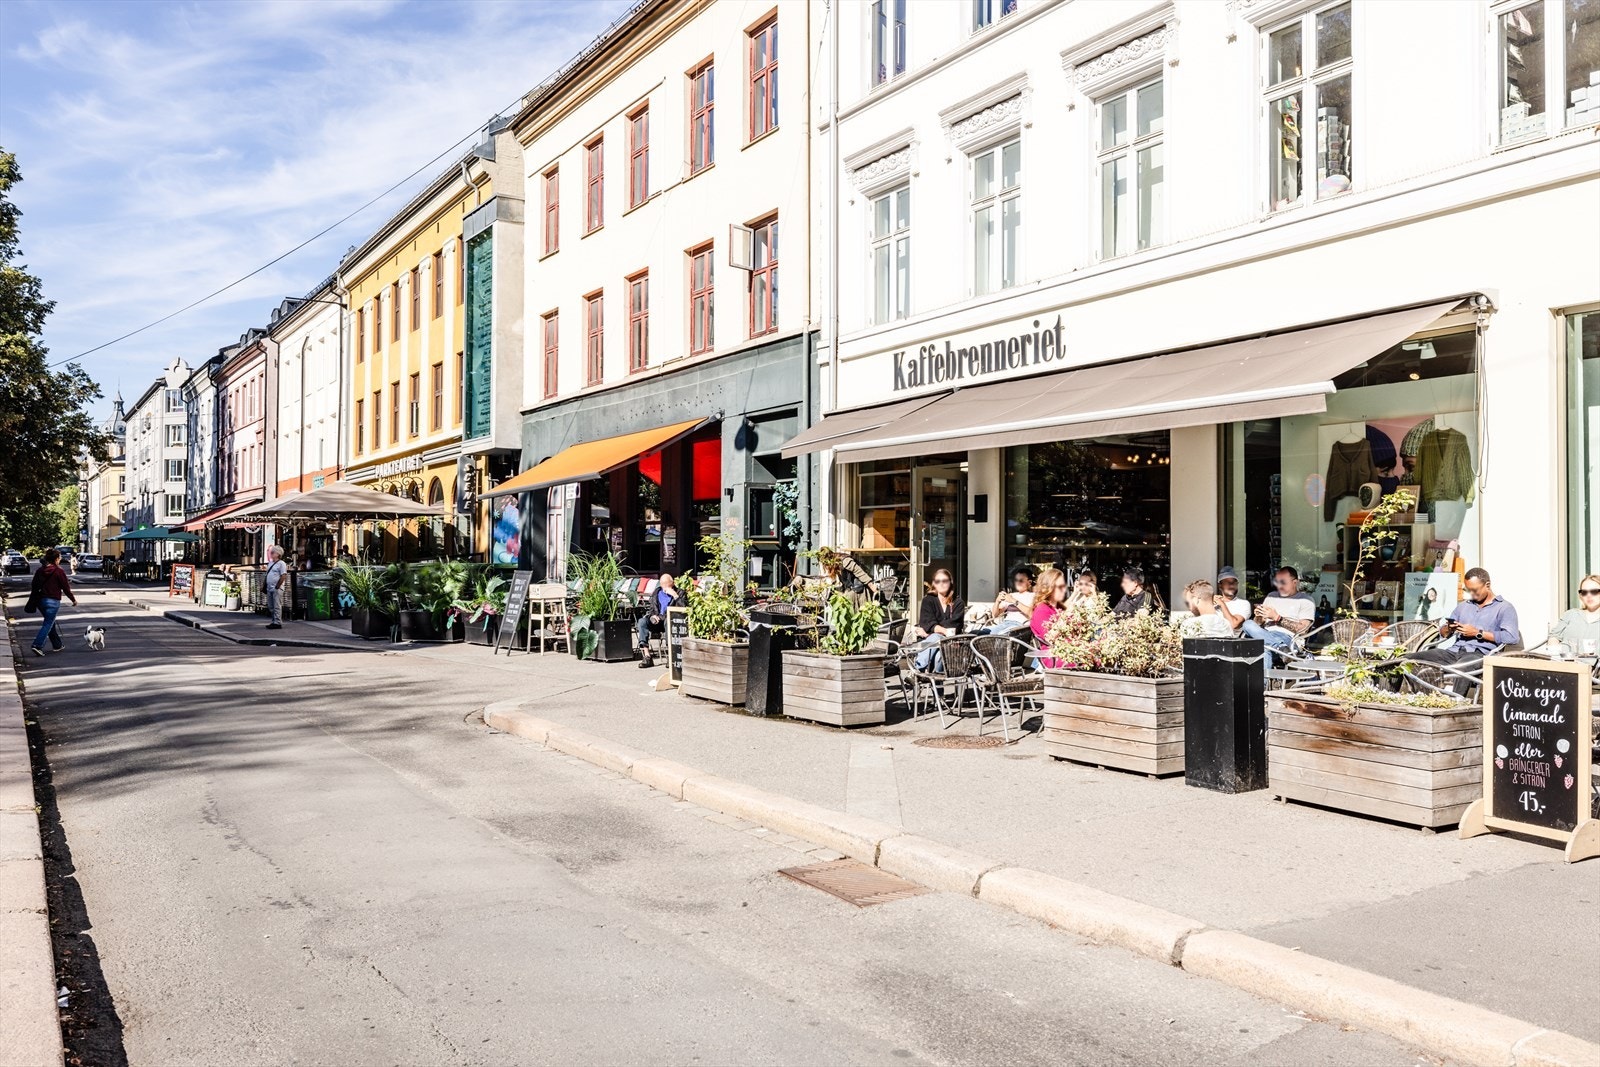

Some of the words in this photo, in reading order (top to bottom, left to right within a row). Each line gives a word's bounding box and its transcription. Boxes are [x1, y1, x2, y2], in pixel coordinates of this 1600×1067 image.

[893, 314, 1066, 391] Kaffebrenneriet
[375, 454, 423, 478] PARKTEATRET
[463, 464, 473, 509] SCENE
[1496, 677, 1532, 698] Vår
[1534, 687, 1568, 706] egen
[1502, 702, 1565, 724] limonade
[1512, 723, 1541, 740] SITRON
[1514, 743, 1544, 759] eller
[1512, 772, 1518, 784] &
[1520, 773, 1546, 789] SITRON
[1519, 791, 1546, 814] 45,-
